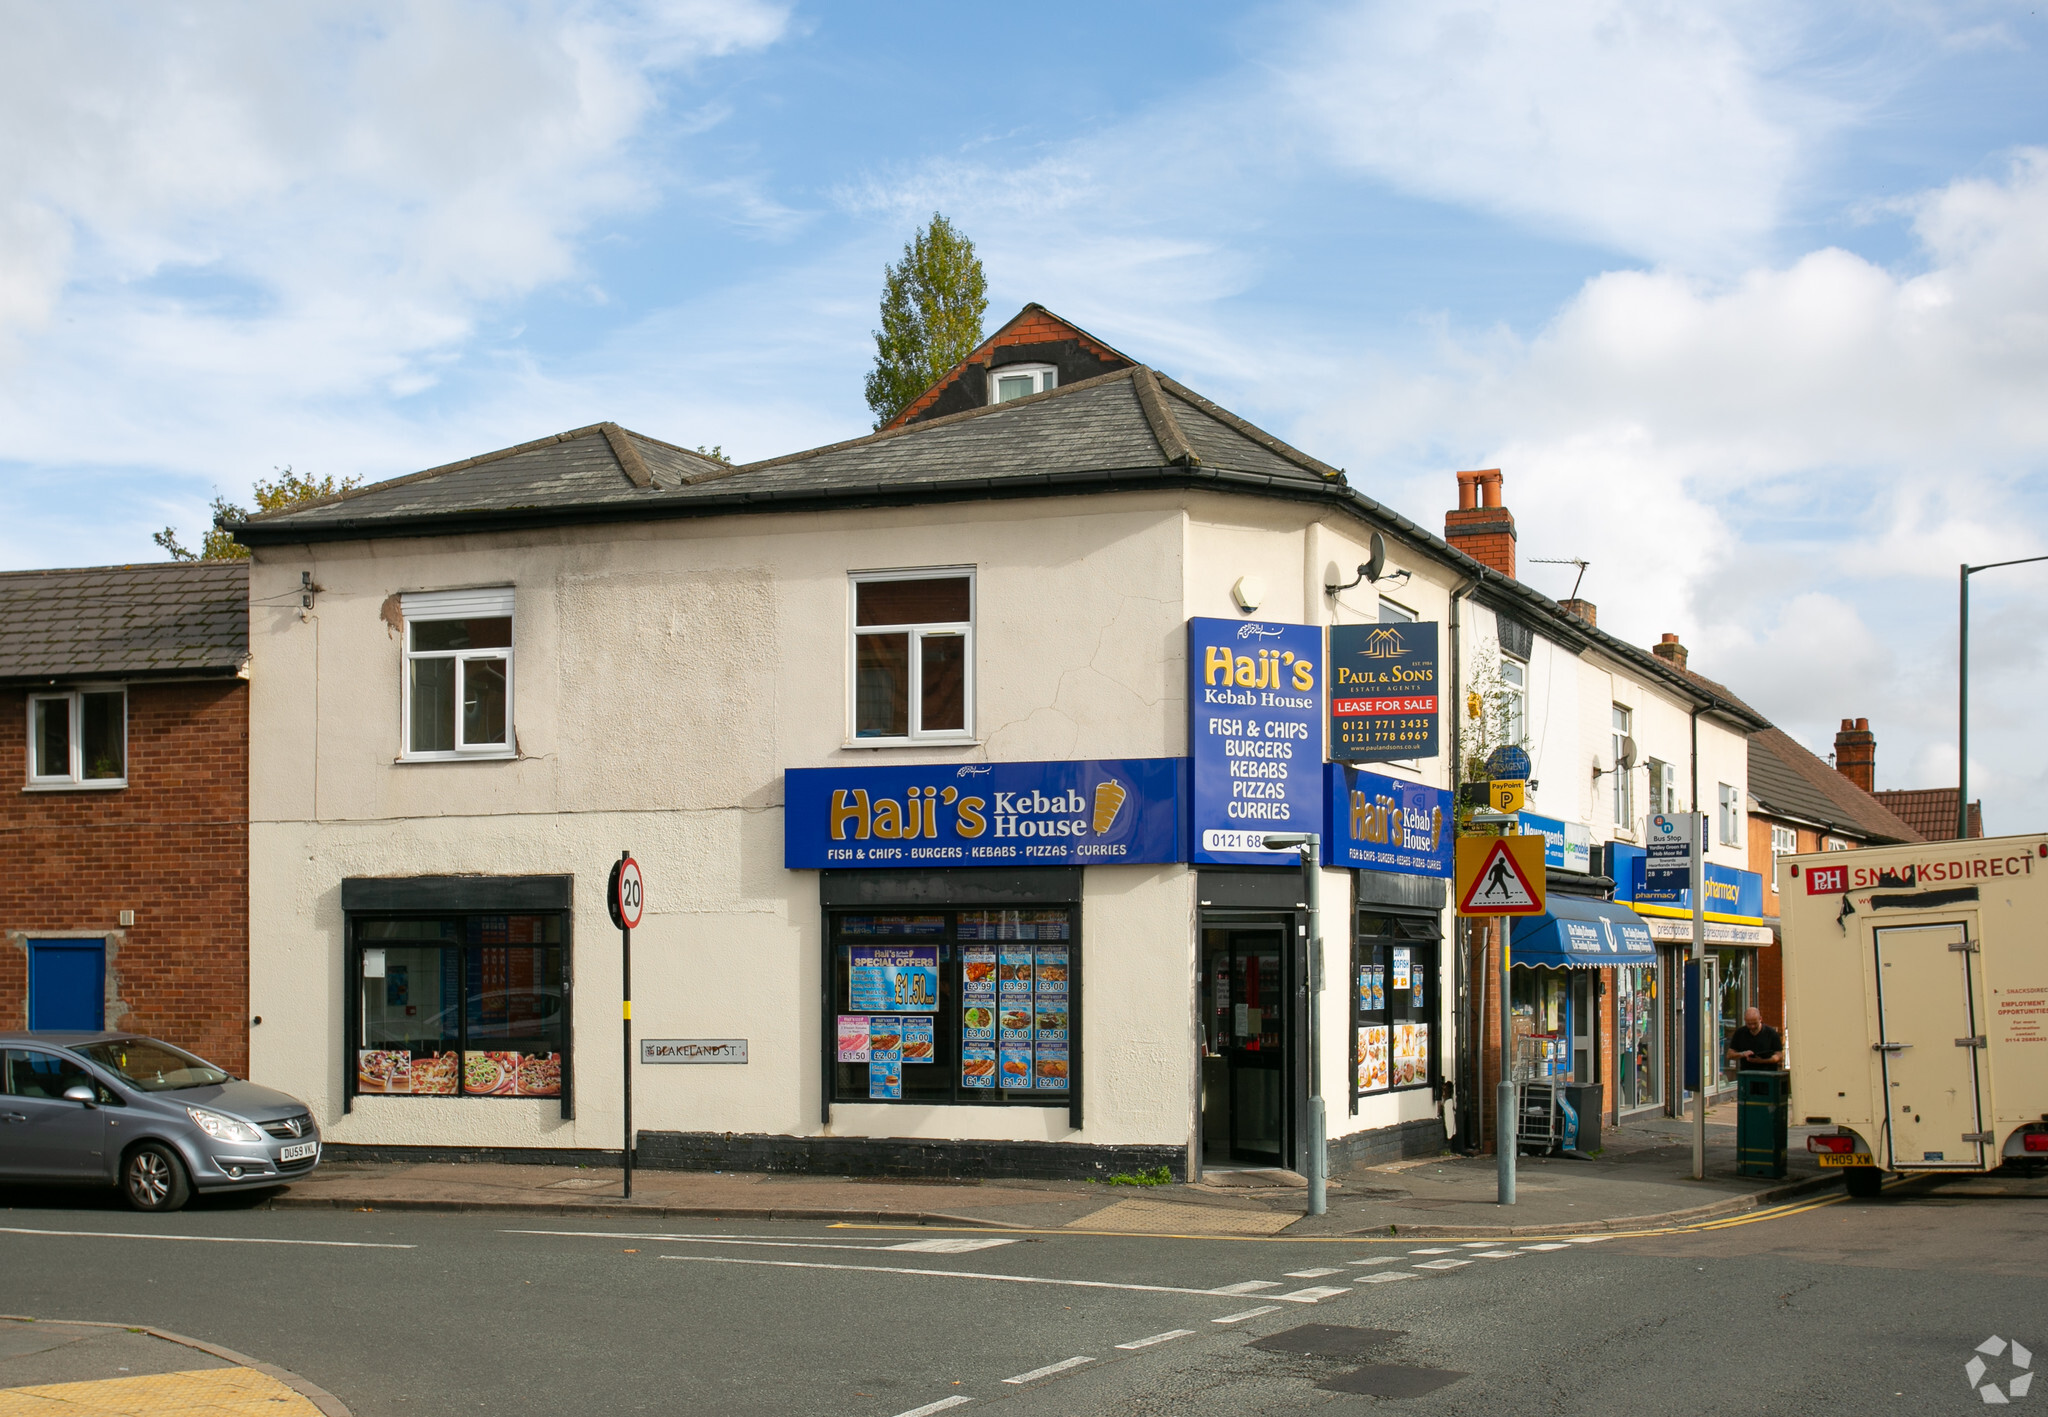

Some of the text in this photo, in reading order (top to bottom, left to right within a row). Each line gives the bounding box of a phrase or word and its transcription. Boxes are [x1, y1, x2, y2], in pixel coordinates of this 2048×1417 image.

[1205, 645, 1314, 691] Haji's
[1337, 665, 1433, 684] PAUL & SONS
[1204, 688, 1313, 709] Kebab House
[1338, 699, 1432, 712] LEASE FOR SALE
[1209, 718, 1308, 740] FISH & CHIPS
[1342, 719, 1429, 730] 0121 771 3435
[1342, 731, 1428, 742] 0121 778 6969
[1225, 740, 1292, 760] BURGERS
[1350, 744, 1420, 752] www.paulandsons.co.uk
[1230, 760, 1288, 780] KEBABS
[1232, 781, 1286, 799] PIZZAS
[993, 789, 1086, 814] Kebab
[1500, 791, 1513, 809] P
[830, 785, 987, 840] Haji's
[1227, 801, 1291, 820] CURRIES
[1350, 789, 1404, 847] Haji's
[1403, 807, 1430, 831] Kebab
[993, 814, 1087, 838] House
[1212, 833, 1242, 848] 0121
[1403, 828, 1431, 852] House
[828, 844, 1127, 860] FISH & CHIPS BURGERS KEBABS PIZZAS CURRIES
[1349, 848, 1359, 859] FISH
[1363, 850, 1376, 862] CHIPS
[1377, 851, 1395, 865] BURGERS
[1396, 854, 1411, 867] KEBABS
[1412, 857, 1425, 868] PIZZAS
[1427, 859, 1441, 870] CURRIES
[1813, 870, 1841, 891] P&H
[624, 879, 640, 907] 20
[1635, 892, 1677, 900] pharmacy
[1705, 876, 1740, 905] pharmacy
[1657, 925, 1689, 937] prescriptions
[855, 958, 934, 967] SPECIAL OFFERS
[895, 973, 926, 1004] £1.50
[968, 982, 992, 990] £3.99
[1003, 982, 1028, 990] £3.99
[1039, 982, 1064, 990] £3.00
[906, 1033, 929, 1041] £1.00
[967, 1030, 991, 1038] £3.00
[1004, 1030, 1028, 1038] £3.00
[1039, 1030, 1064, 1038] £2.50
[656, 1045, 720, 1057] BLAKELAND
[843, 1051, 866, 1060] £1.50
[874, 1051, 897, 1060] £2.00
[967, 1077, 991, 1085] £1.50
[1003, 1077, 1028, 1086] £1.20
[1039, 1078, 1064, 1086] £2.00
[284, 1145, 303, 1159] DU59
[1824, 1154, 1870, 1165] YH09 XW
